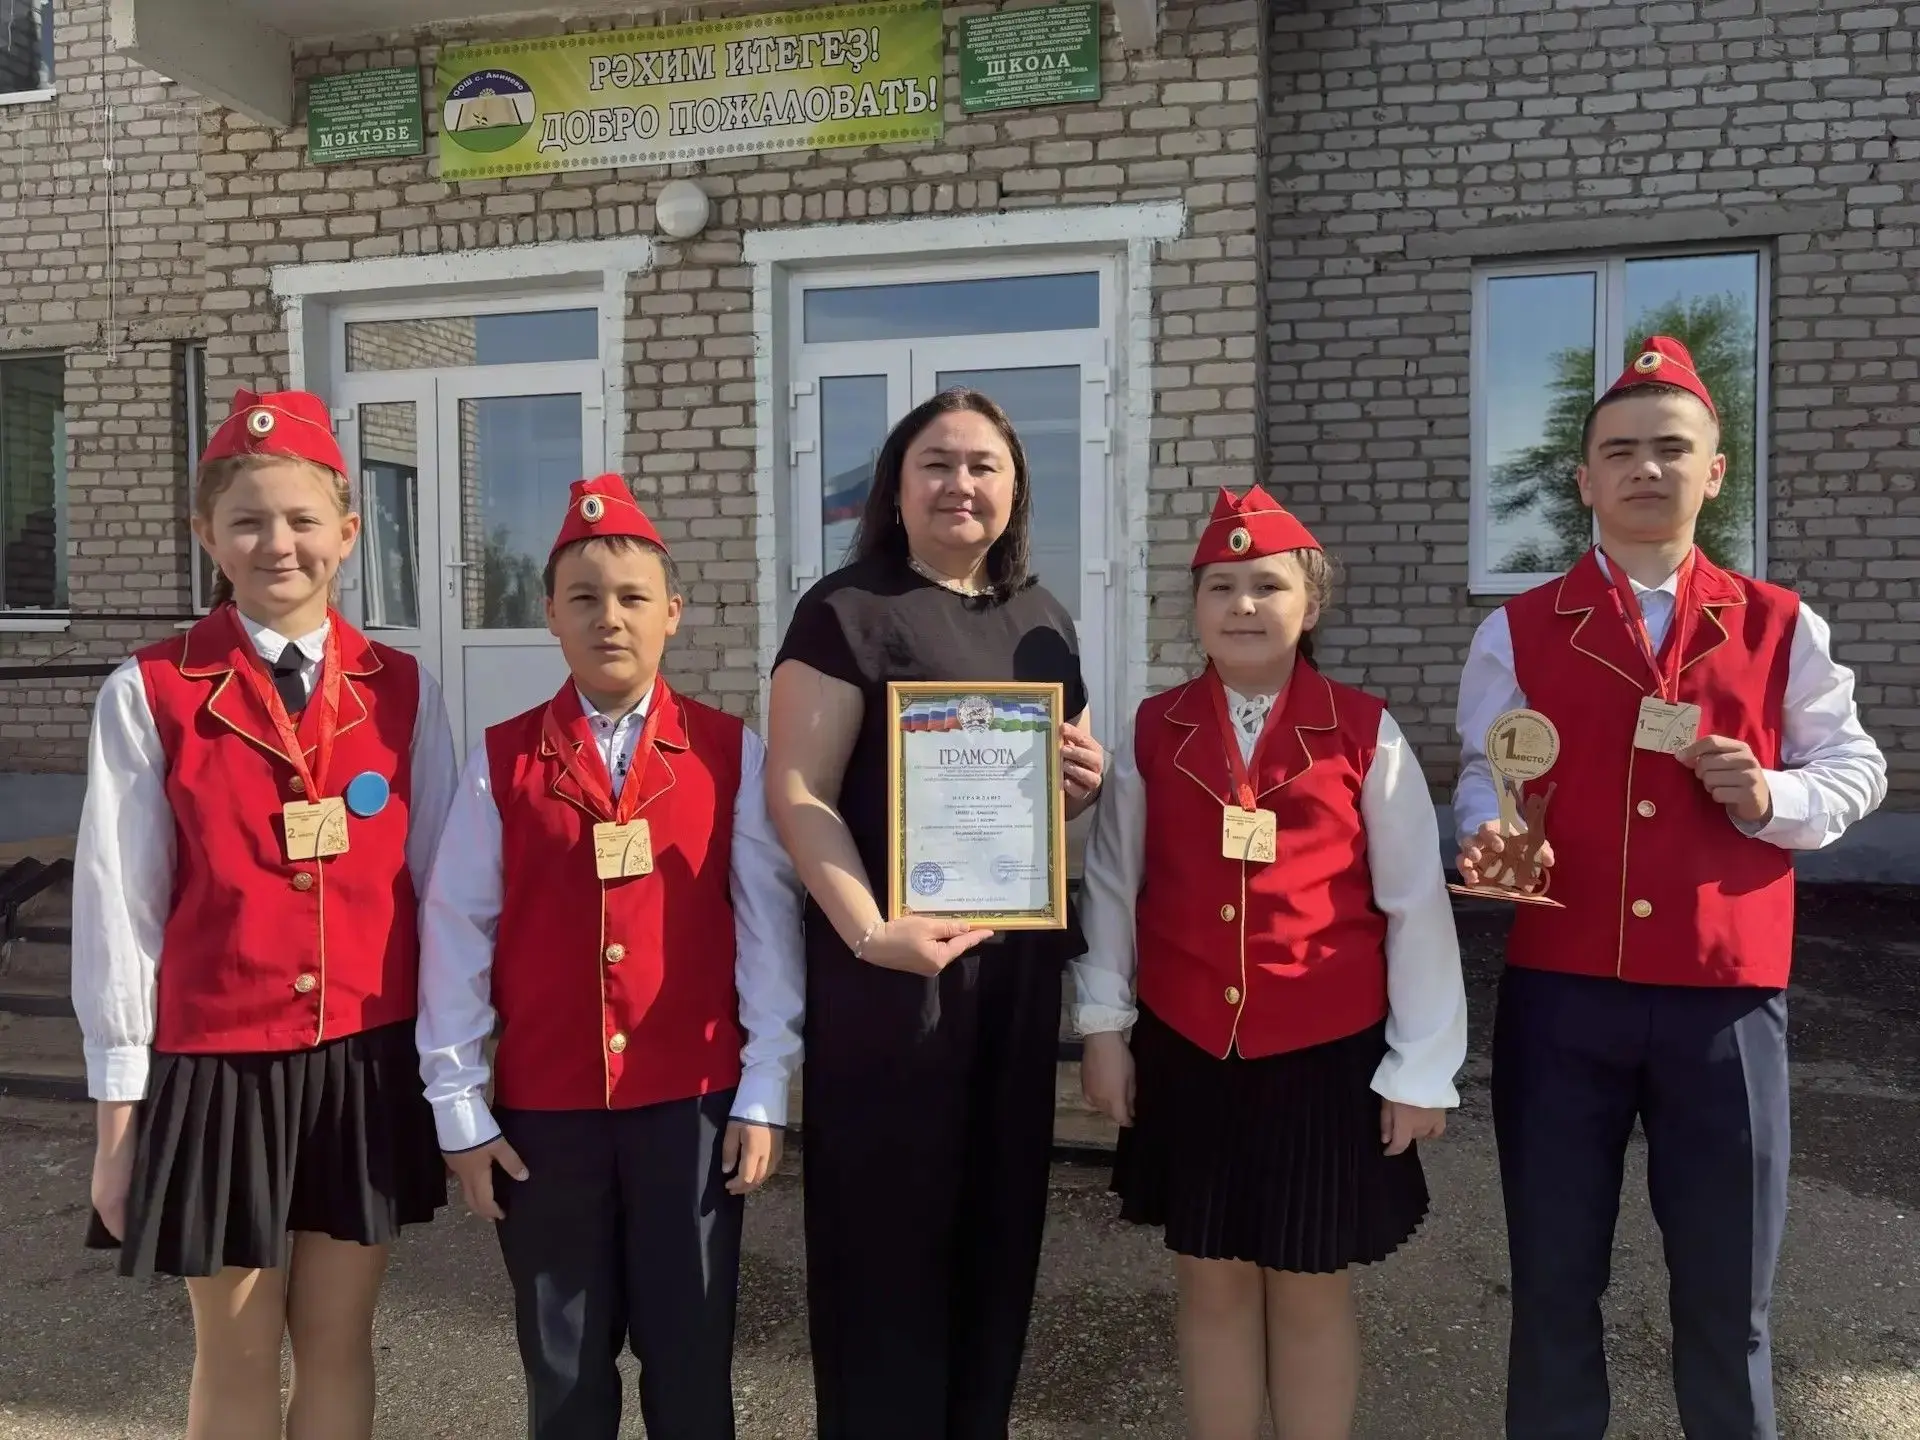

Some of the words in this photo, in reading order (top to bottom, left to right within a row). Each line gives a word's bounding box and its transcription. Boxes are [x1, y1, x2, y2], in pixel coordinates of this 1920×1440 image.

[589, 39, 714, 91] РӘХИМ
[987, 52, 1071, 76] ШКОЛА
[453, 79, 472, 96] ООШ
[486, 73, 524, 90] Аминево
[537, 107, 659, 154] ДОБРО
[669, 76, 938, 136] ПОЖАЛОВАТЬ!
[320, 126, 410, 147] МӘКТӘБЕ
[1640, 719, 1645, 729] 1
[1500, 728, 1516, 759] 1
[939, 748, 1016, 765] ГРАМОТА
[287, 828, 296, 839] 2
[1225, 828, 1230, 839] 1
[597, 848, 604, 859] 2
